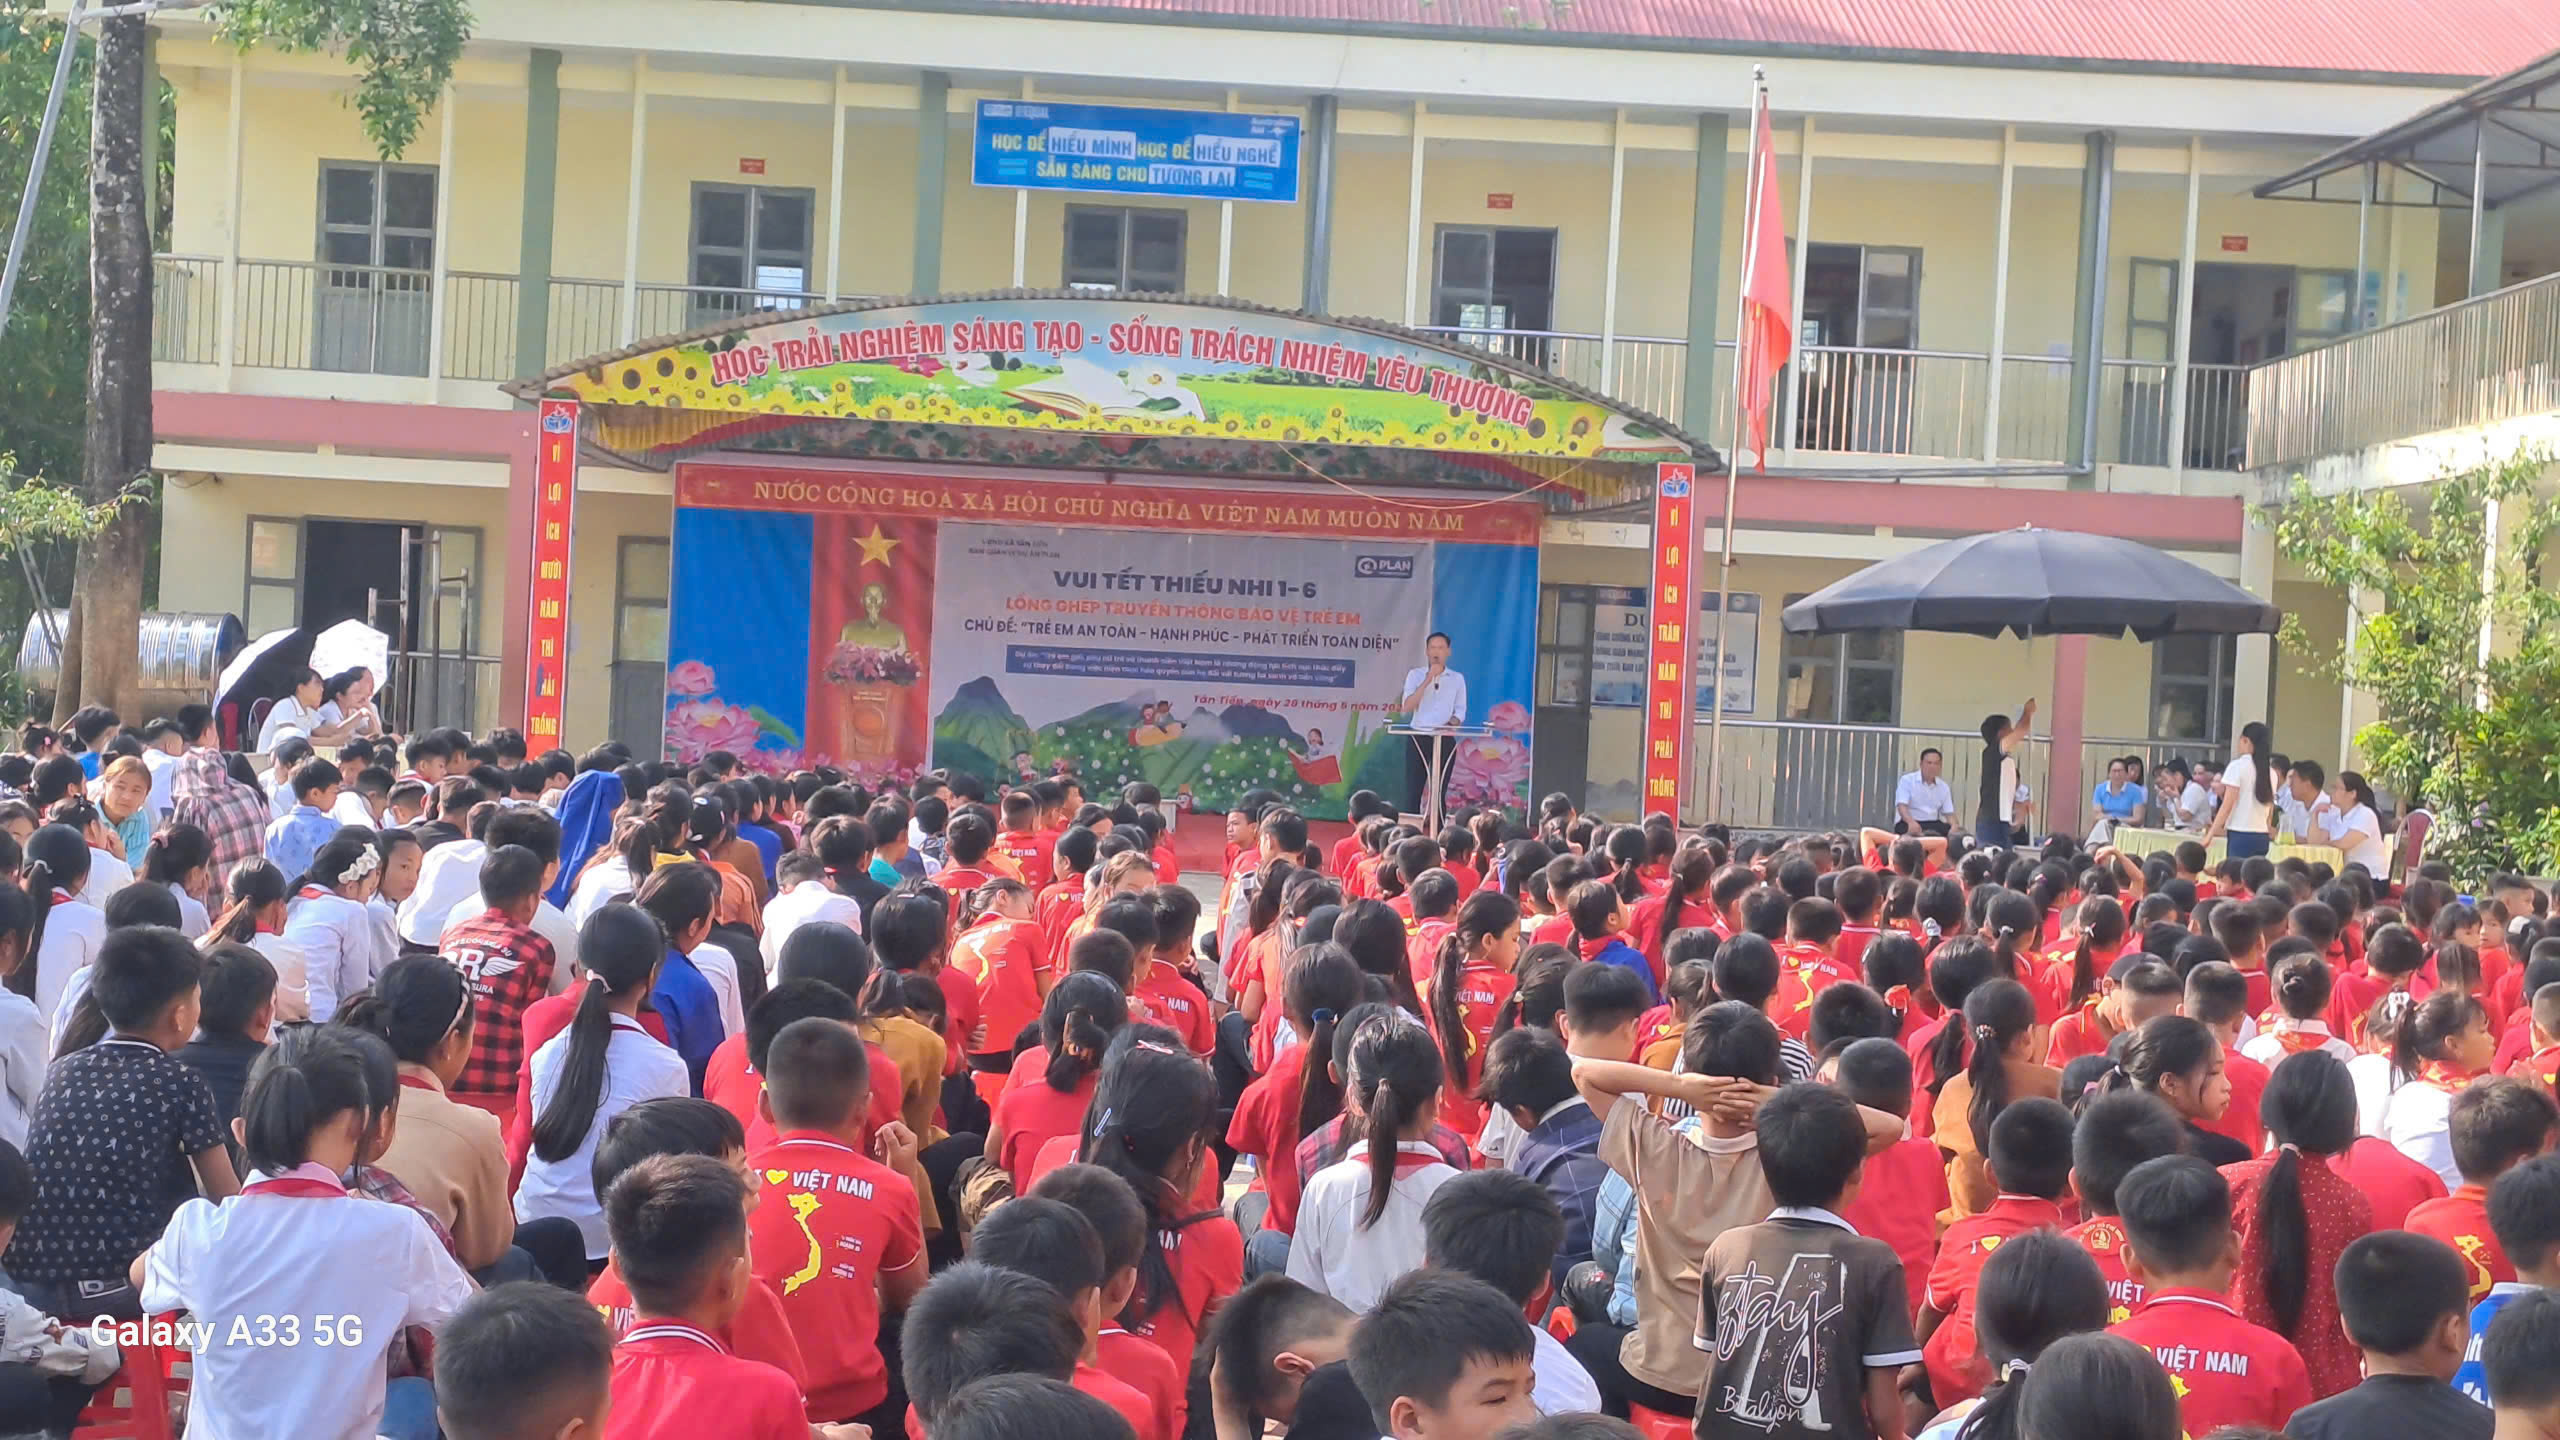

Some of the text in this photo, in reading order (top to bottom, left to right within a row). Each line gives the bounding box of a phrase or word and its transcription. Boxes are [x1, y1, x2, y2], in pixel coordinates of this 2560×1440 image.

[992, 133, 1021, 152] HỌC
[1051, 130, 1086, 154] HIỂU
[1091, 134, 1132, 157] MÌNH
[1136, 143, 1167, 161] HỌC
[1195, 138, 1231, 162] HIỂU
[1071, 160, 1112, 181] SÀNG
[1151, 167, 1202, 186] TƯƠNG
[1207, 171, 1235, 188] LAI
[712, 346, 768, 387] HỌC
[772, 325, 835, 372] TRẢI
[839, 319, 945, 366] NGHIỆM
[952, 316, 1025, 353] SÁNG
[1032, 320, 1083, 358] TẠO
[1108, 314, 1182, 357] SỐNG
[1189, 325, 1276, 366] TRÁCH
[1279, 339, 1370, 385] NHIỆM
[1373, 356, 1425, 398] YÊU
[1429, 371, 1535, 430] THƯƠNG
[551, 440, 562, 463] VÌ
[754, 479, 822, 502] NƯỚC
[961, 489, 996, 512] XÃ
[1003, 490, 1046, 517] HỘI
[1054, 490, 1104, 516] CHỦ
[1111, 498, 1192, 521] NGHĨA
[1200, 499, 1257, 526] VIỆT
[1264, 508, 1321, 527] NAM
[1327, 505, 1401, 529] MUÔN
[1407, 508, 1464, 531] NĂM
[545, 518, 560, 541] ÍCH
[1379, 560, 1411, 571] PLAN
[1053, 570, 1097, 590] VUI
[1102, 567, 1146, 591] TẾT
[1150, 570, 1223, 594] THIẾU
[1228, 578, 1273, 597] NHI
[1664, 581, 1678, 604] ÍCH
[1174, 602, 1234, 621] THÔNG
[1277, 607, 1299, 627] VỆ
[1335, 612, 1361, 626] EM
[964, 616, 994, 632] CHỦ
[1054, 622, 1074, 636] EM
[1076, 624, 1097, 638] AN
[1150, 627, 1190, 645] HẠNH
[1192, 629, 1230, 644] PHÚC
[1243, 630, 1278, 646] PHÁT
[1281, 628, 1319, 647] TRIỂN
[536, 672, 556, 697] HẢI
[1168, 997, 1189, 1013] NAM
[1474, 991, 1495, 1004] NAM
[793, 1168, 874, 1200] VIỆT NAM
[2156, 1344, 2249, 1377] VIỆT NAM
